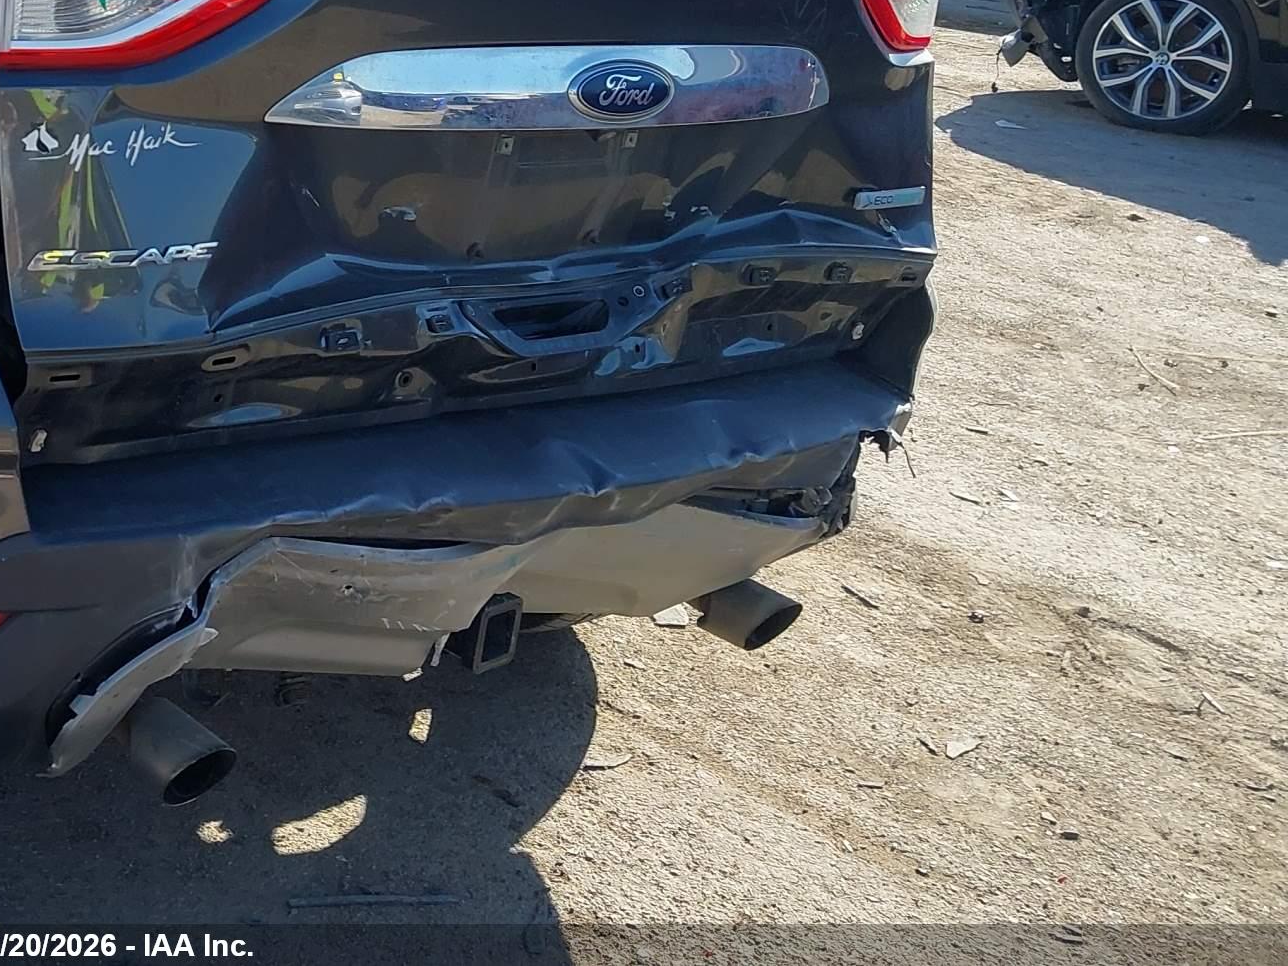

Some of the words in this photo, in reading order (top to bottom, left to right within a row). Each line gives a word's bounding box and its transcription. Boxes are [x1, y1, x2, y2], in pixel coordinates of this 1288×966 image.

[598, 73, 656, 107] Ford
[28, 133, 116, 172] Mac
[125, 122, 202, 167] Haik
[27, 241, 219, 272] ESCAPE
